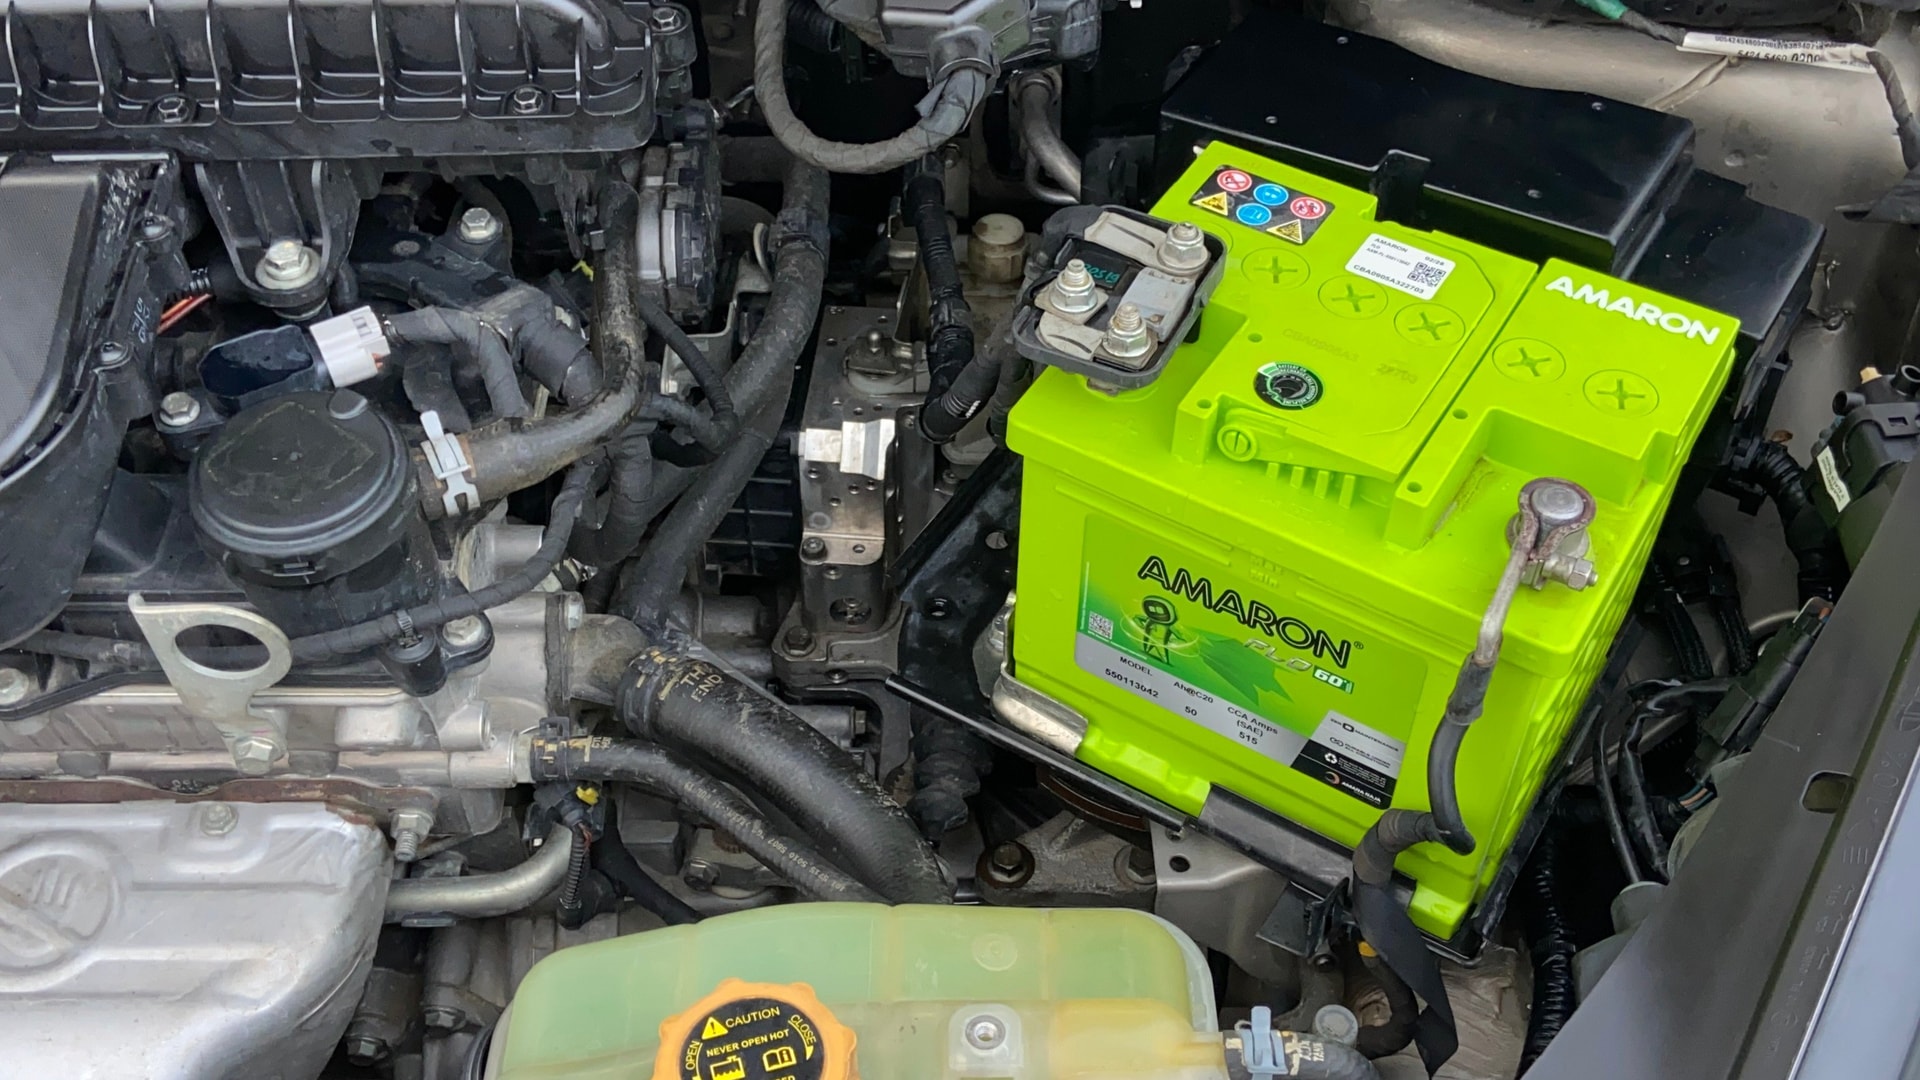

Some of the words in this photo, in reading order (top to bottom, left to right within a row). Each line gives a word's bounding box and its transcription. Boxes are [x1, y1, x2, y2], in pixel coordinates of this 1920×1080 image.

[1375, 238, 1408, 253] AMARON
[1545, 276, 1721, 345] AMARON
[1120, 656, 1153, 677] MODEL
[1243, 637, 1313, 672] FLO
[691, 673, 722, 702] END
[1105, 667, 1159, 699] 550113042
[1173, 681, 1214, 704] Ah@C20
[1184, 706, 1198, 717] 50
[1227, 706, 1250, 721] CCA
[1250, 716, 1278, 735] Amps
[1236, 720, 1263, 737] (SAE)
[1239, 731, 1258, 746] 515
[725, 1006, 781, 1028] CAUTION
[790, 1014, 817, 1045] CLOSE
[685, 1040, 700, 1071] OPEN
[706, 1042, 740, 1058] NEVER
[741, 1033, 769, 1049] OPEN
[769, 1028, 791, 1042] HOT
